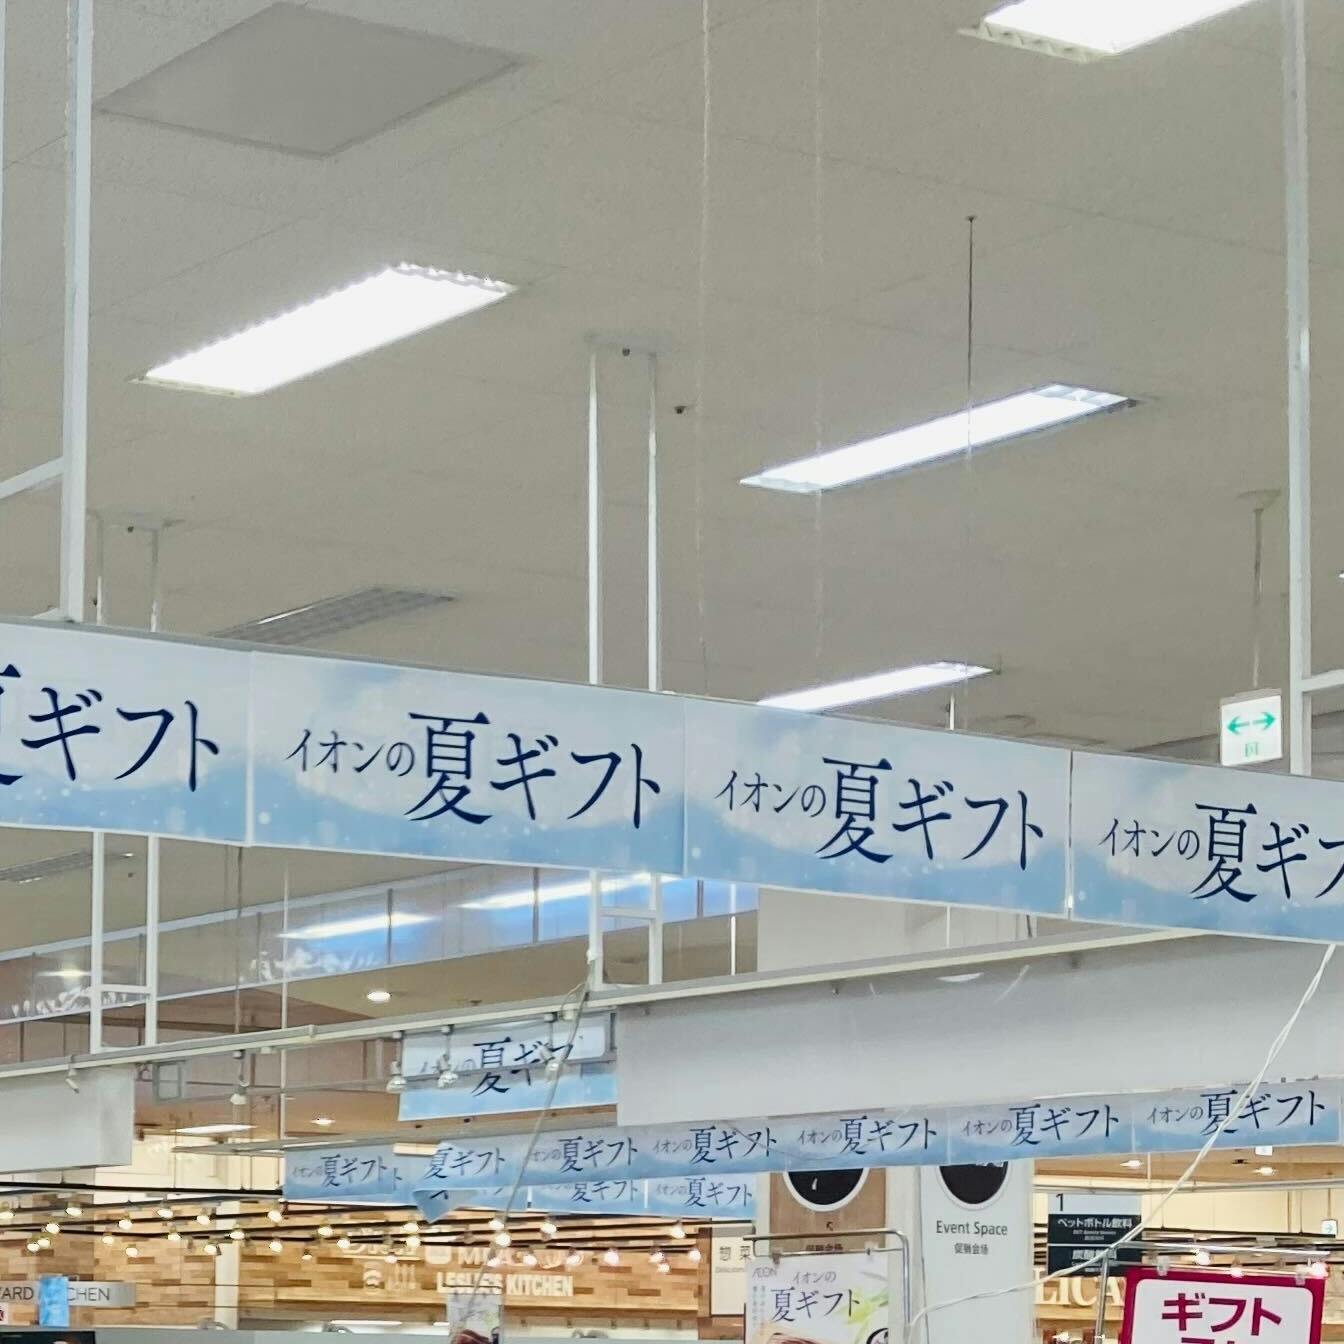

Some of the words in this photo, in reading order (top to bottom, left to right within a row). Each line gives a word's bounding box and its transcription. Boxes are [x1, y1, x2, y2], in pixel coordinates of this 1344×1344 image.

[285, 711, 662, 830] イオンの夏ギフト
[714, 756, 1045, 871] イオンの夏ギフト
[798, 1115, 938, 1155] イオンの夏ギフト
[962, 1104, 1120, 1146] イオンの夏ギフト
[1055, 1192, 1064, 1212] 1
[935, 1220, 971, 1235] Event
[974, 1222, 1009, 1237] Space
[1057, 1217, 1133, 1229] ペットボトル飲料
[770, 1287, 860, 1322] 夏ギフト
[1161, 1293, 1283, 1337] ギフト
